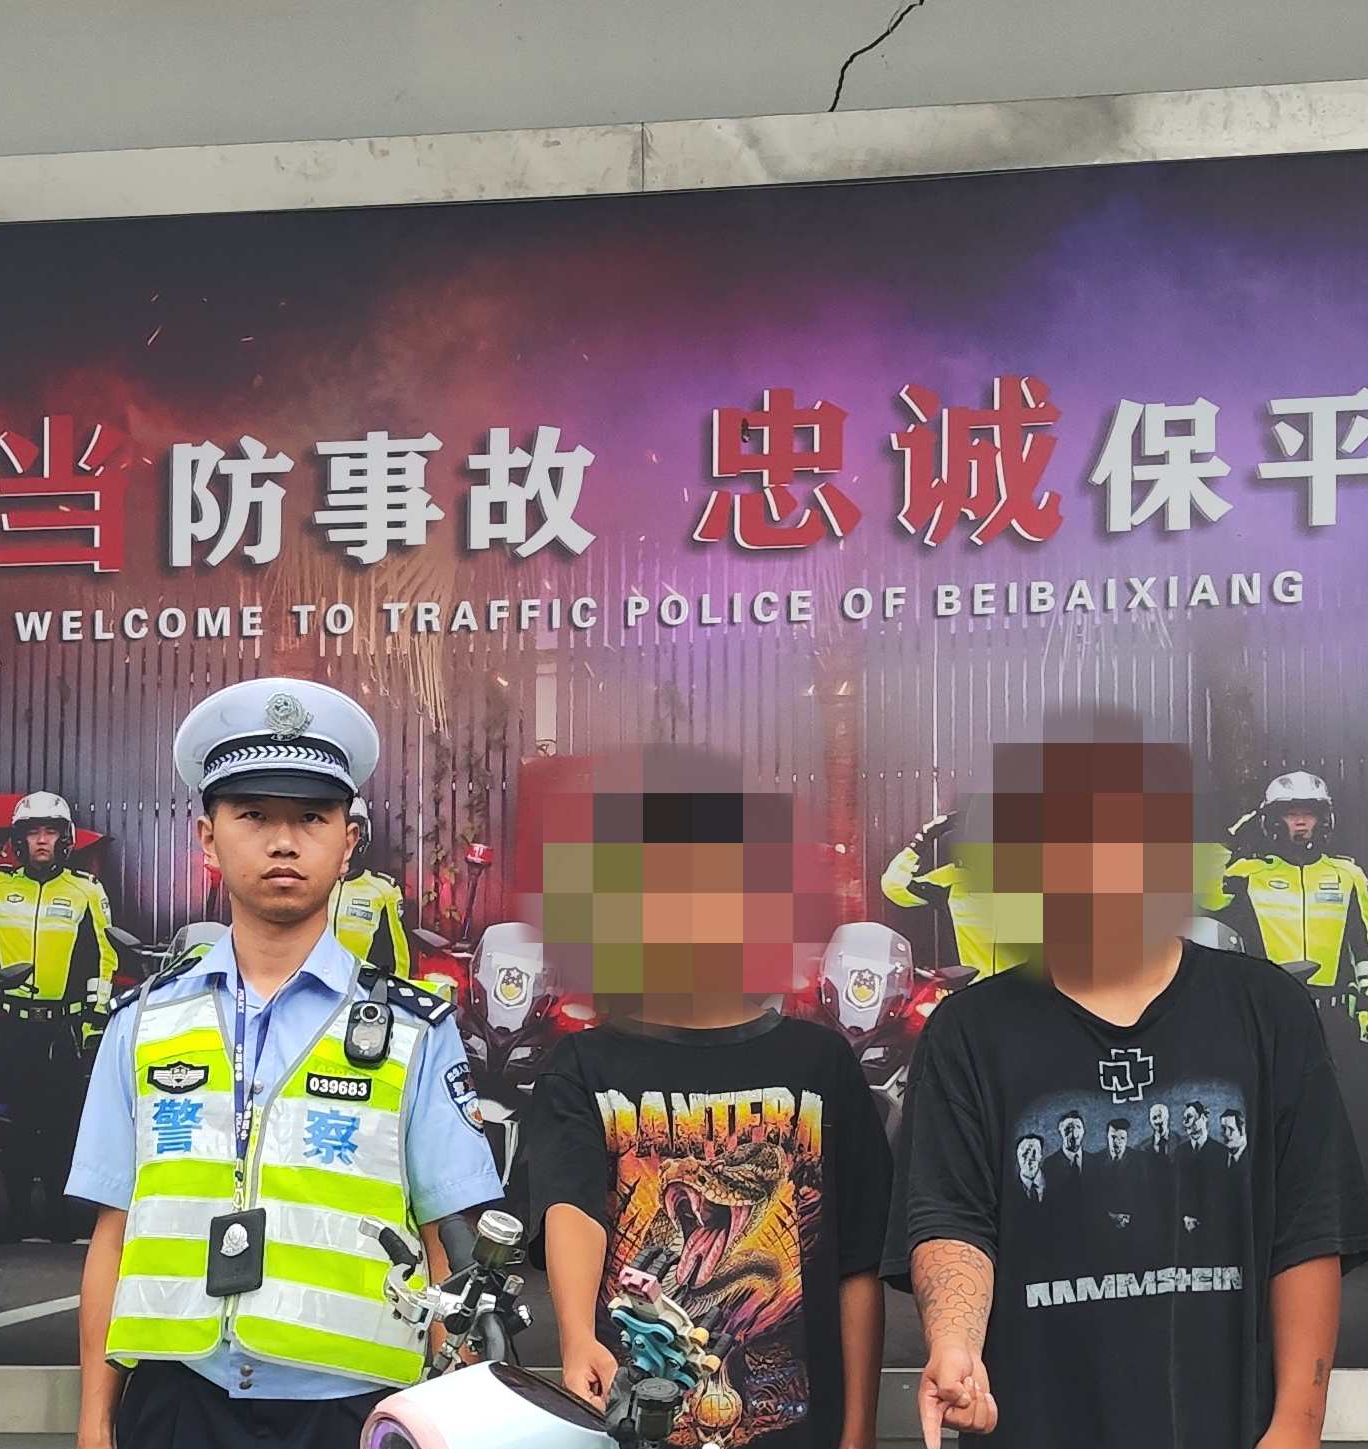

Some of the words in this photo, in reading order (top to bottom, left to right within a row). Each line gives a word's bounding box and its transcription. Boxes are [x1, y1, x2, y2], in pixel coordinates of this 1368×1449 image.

[14, 606, 263, 643] WELCOME
[292, 601, 356, 637] TO
[383, 596, 598, 633] TRAFFIC
[625, 588, 813, 628] POLICE
[843, 586, 908, 619] OF
[934, 569, 1305, 617] BEIBAIXIANG
[309, 1077, 368, 1097] 039683
[594, 1086, 824, 1158] PANTERA
[152, 1098, 204, 1155] 警
[302, 1109, 359, 1166] 察
